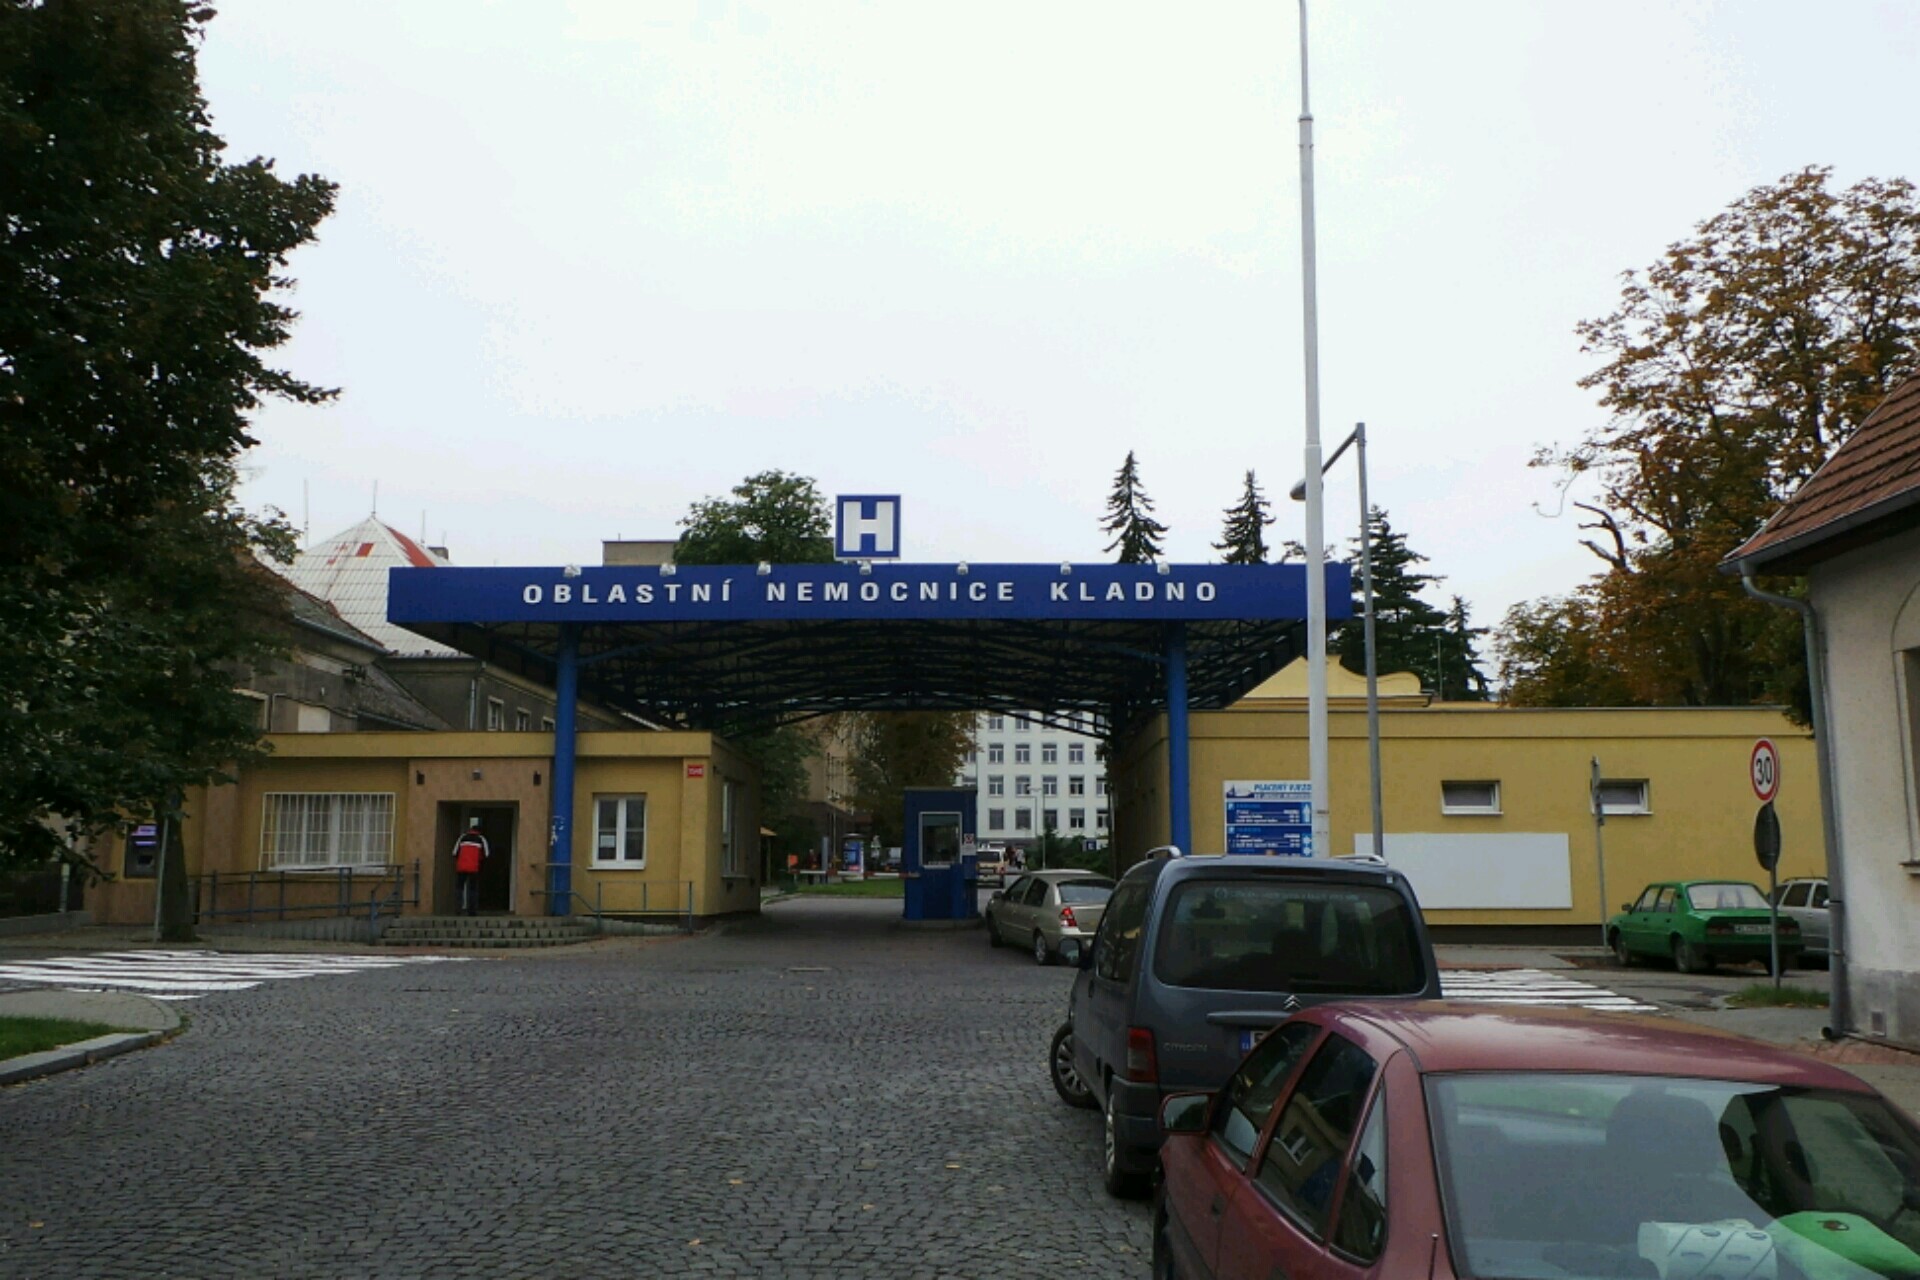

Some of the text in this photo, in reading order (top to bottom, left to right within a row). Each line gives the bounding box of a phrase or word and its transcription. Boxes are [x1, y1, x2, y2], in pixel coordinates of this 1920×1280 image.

[843, 500, 894, 553] H
[523, 578, 1217, 603] OBLASTNÍ NEMOCNICE KLADNO
[1755, 756, 1772, 785] 30
